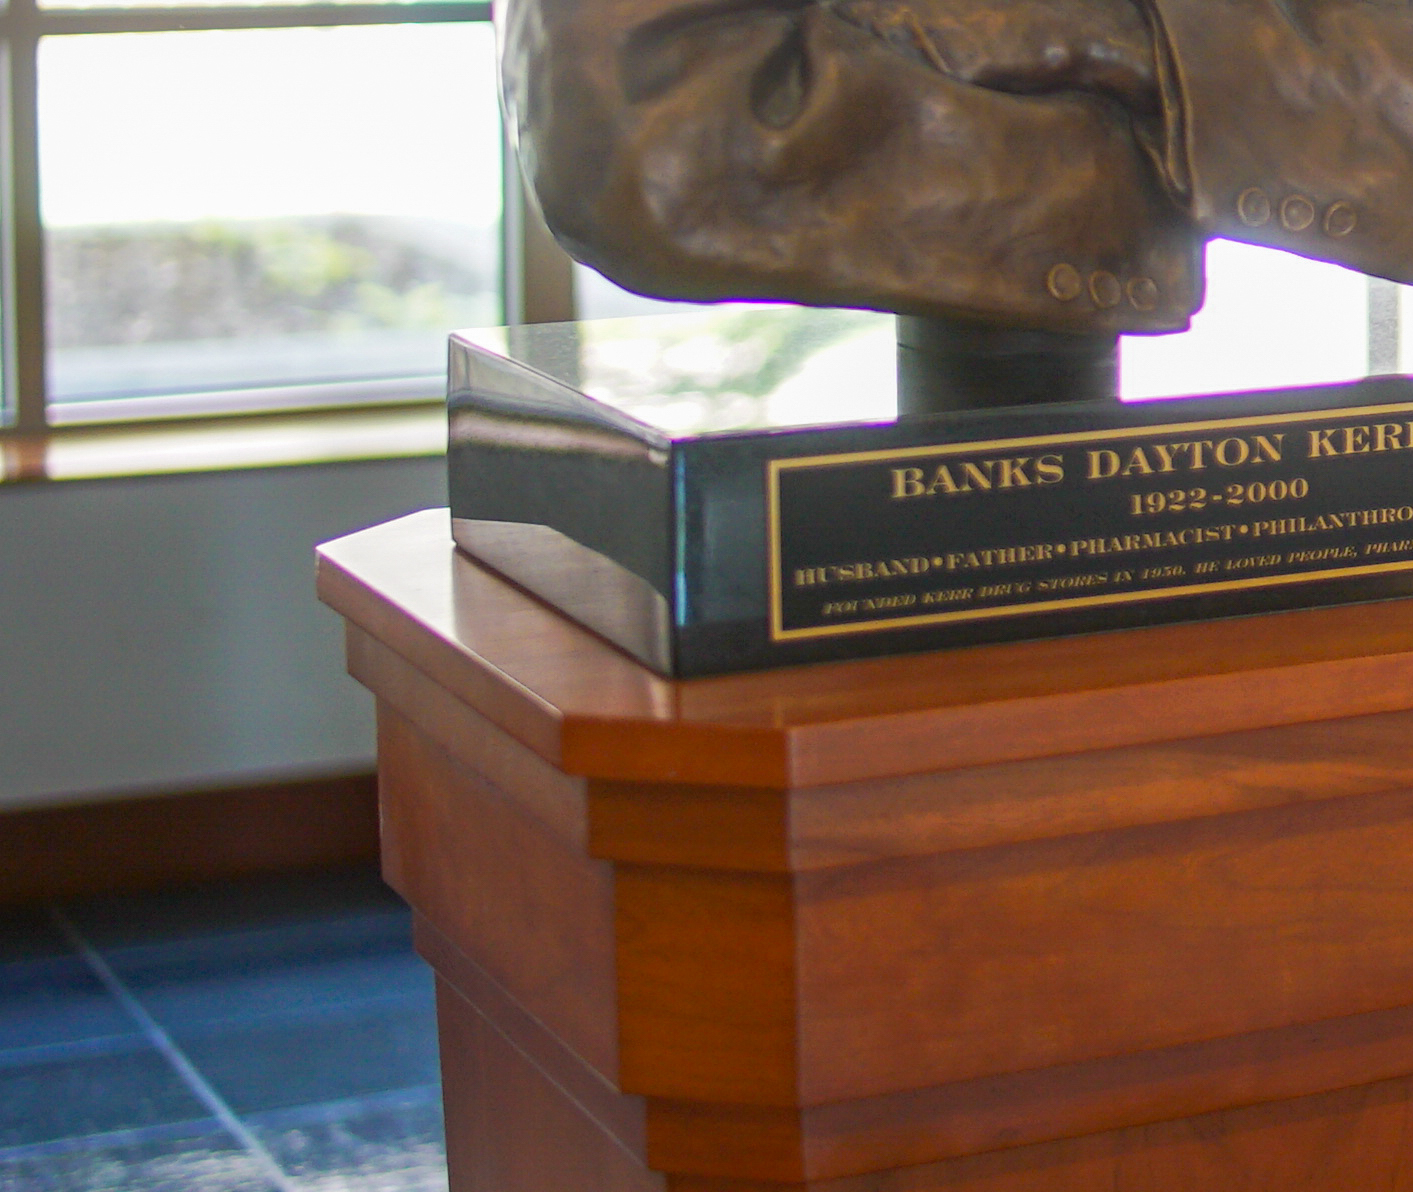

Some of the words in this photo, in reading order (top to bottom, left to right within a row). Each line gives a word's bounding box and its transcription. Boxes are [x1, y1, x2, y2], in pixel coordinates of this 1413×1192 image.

[891, 455, 1065, 499] BANKS
[1087, 433, 1284, 480] DAYTON
[1130, 478, 1309, 514] 1922-2000
[821, 594, 916, 615] FOUNDED
[921, 588, 974, 604] KERR
[978, 580, 1032, 598] DRUG
[1038, 572, 1108, 591] STORES
[1113, 568, 1135, 583] IN
[1194, 560, 1220, 574] HE
[1225, 554, 1281, 570] LOVED
